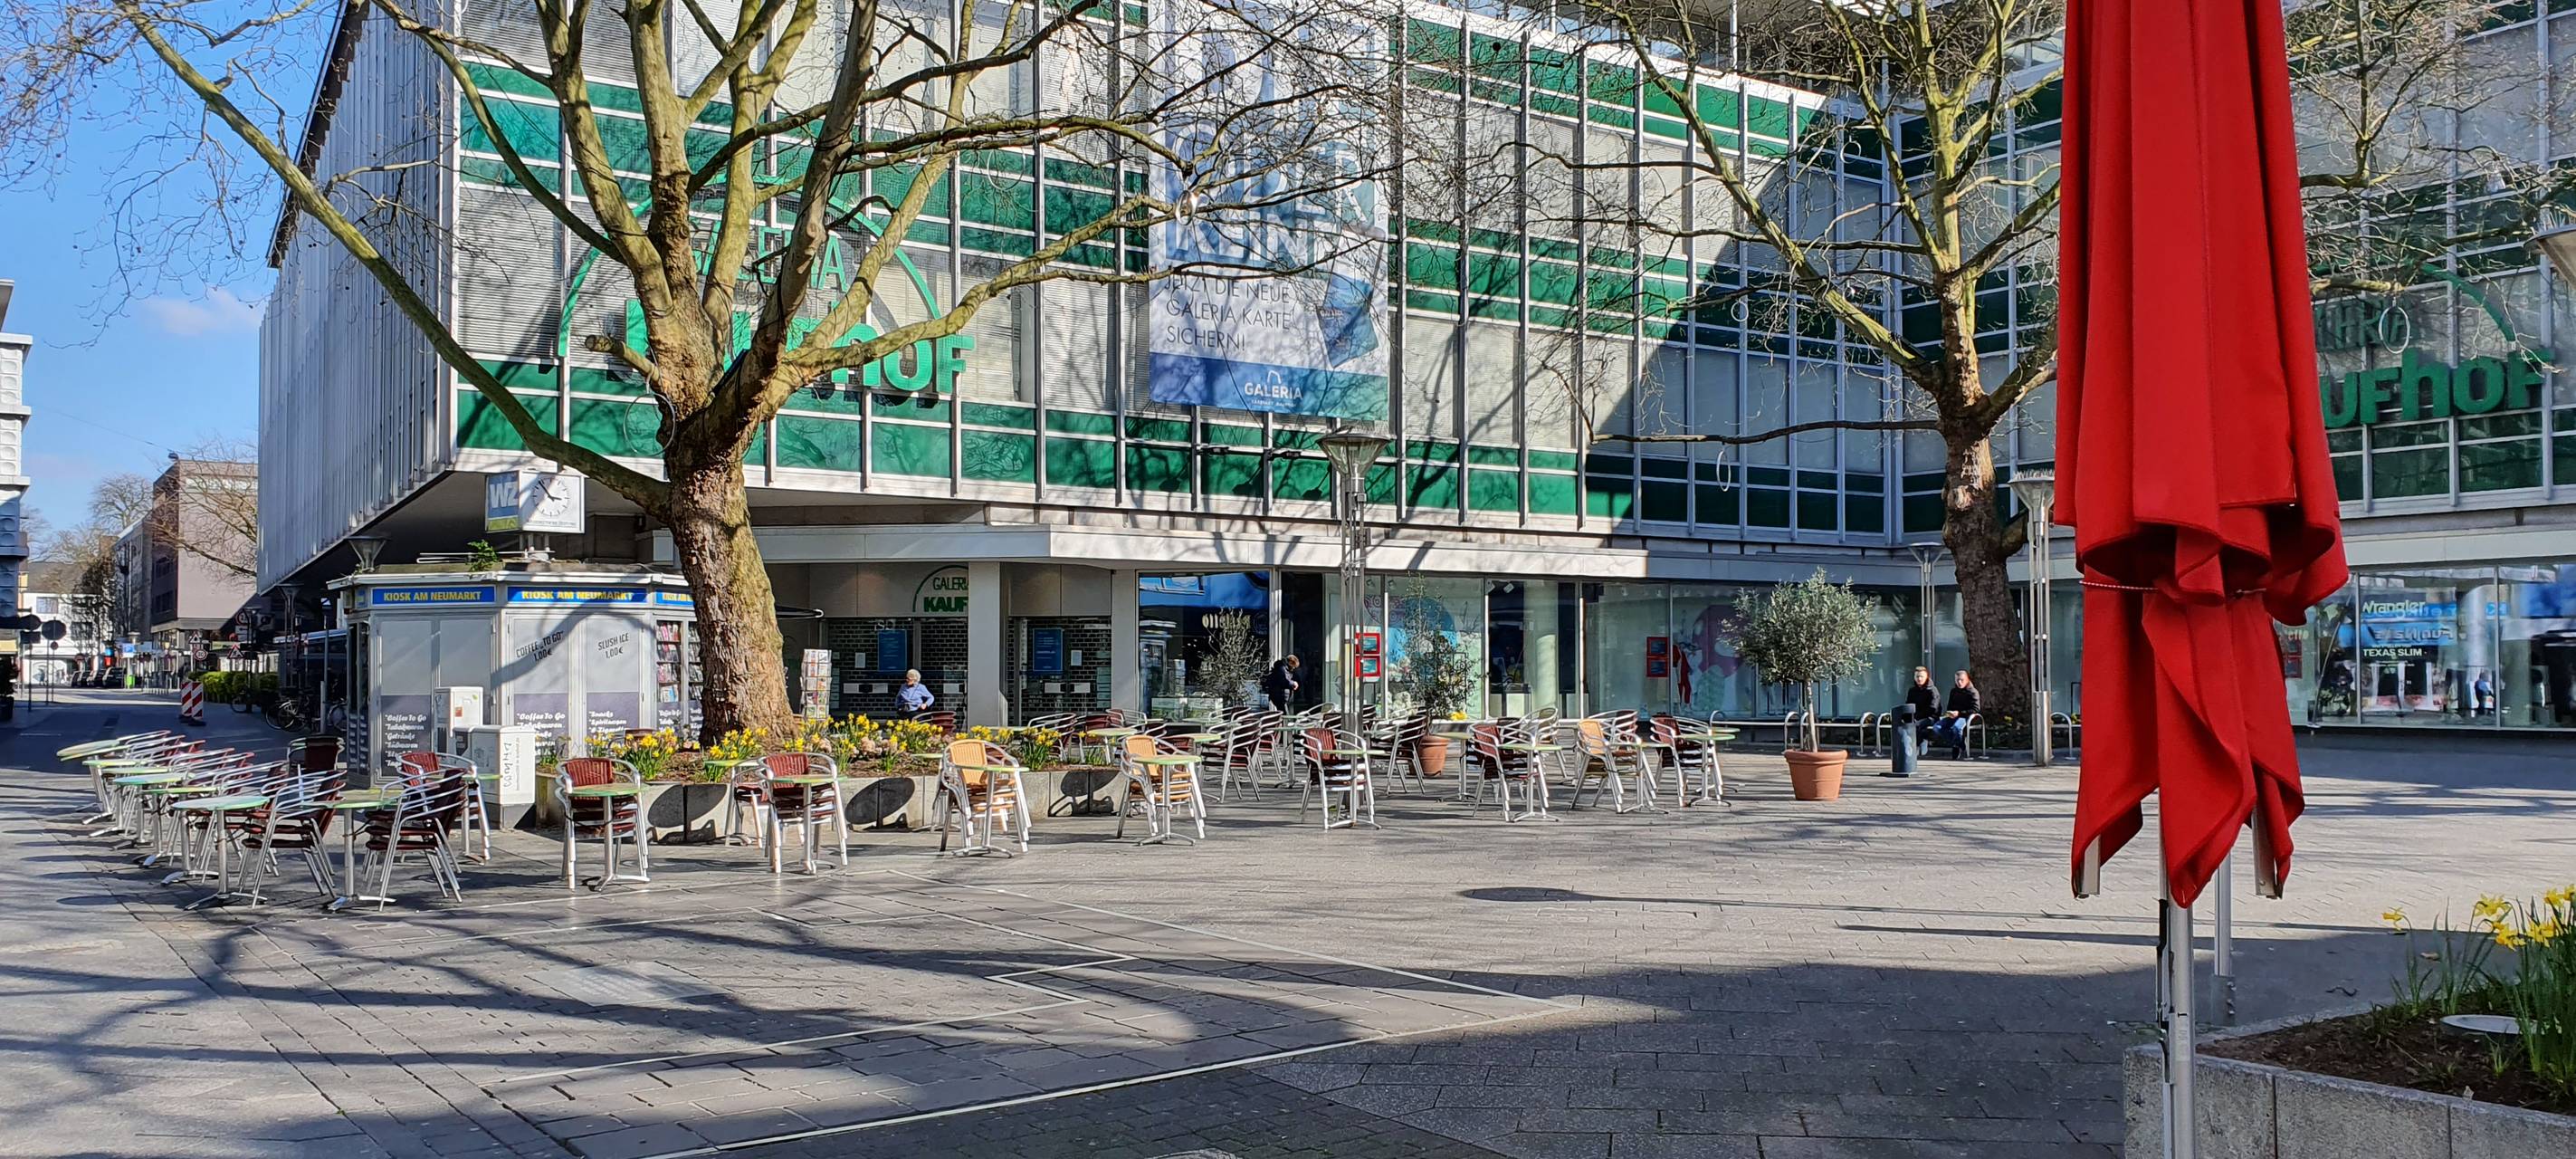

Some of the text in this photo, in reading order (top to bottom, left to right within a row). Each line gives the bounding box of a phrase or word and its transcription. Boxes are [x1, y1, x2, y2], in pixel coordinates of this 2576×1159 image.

[1216, 278, 1240, 299] DIE
[1246, 283, 1290, 304] NEUE
[1167, 300, 1290, 330] GALERIA KARTE
[1167, 325, 1245, 351] SICHERN!
[1245, 382, 1302, 400] GALERIA
[490, 481, 519, 508] WZ
[933, 576, 968, 590] GALERI
[384, 591, 482, 601] KIOSK AM NEUMARKT
[522, 590, 633, 600] KIOSK AM NEUMARKT
[2361, 599, 2426, 619] Wrangler
[516, 641, 539, 657] COFFEE
[598, 632, 629, 650] SLUSH ICE
[2362, 648, 2423, 657] TEXAS SLIM
